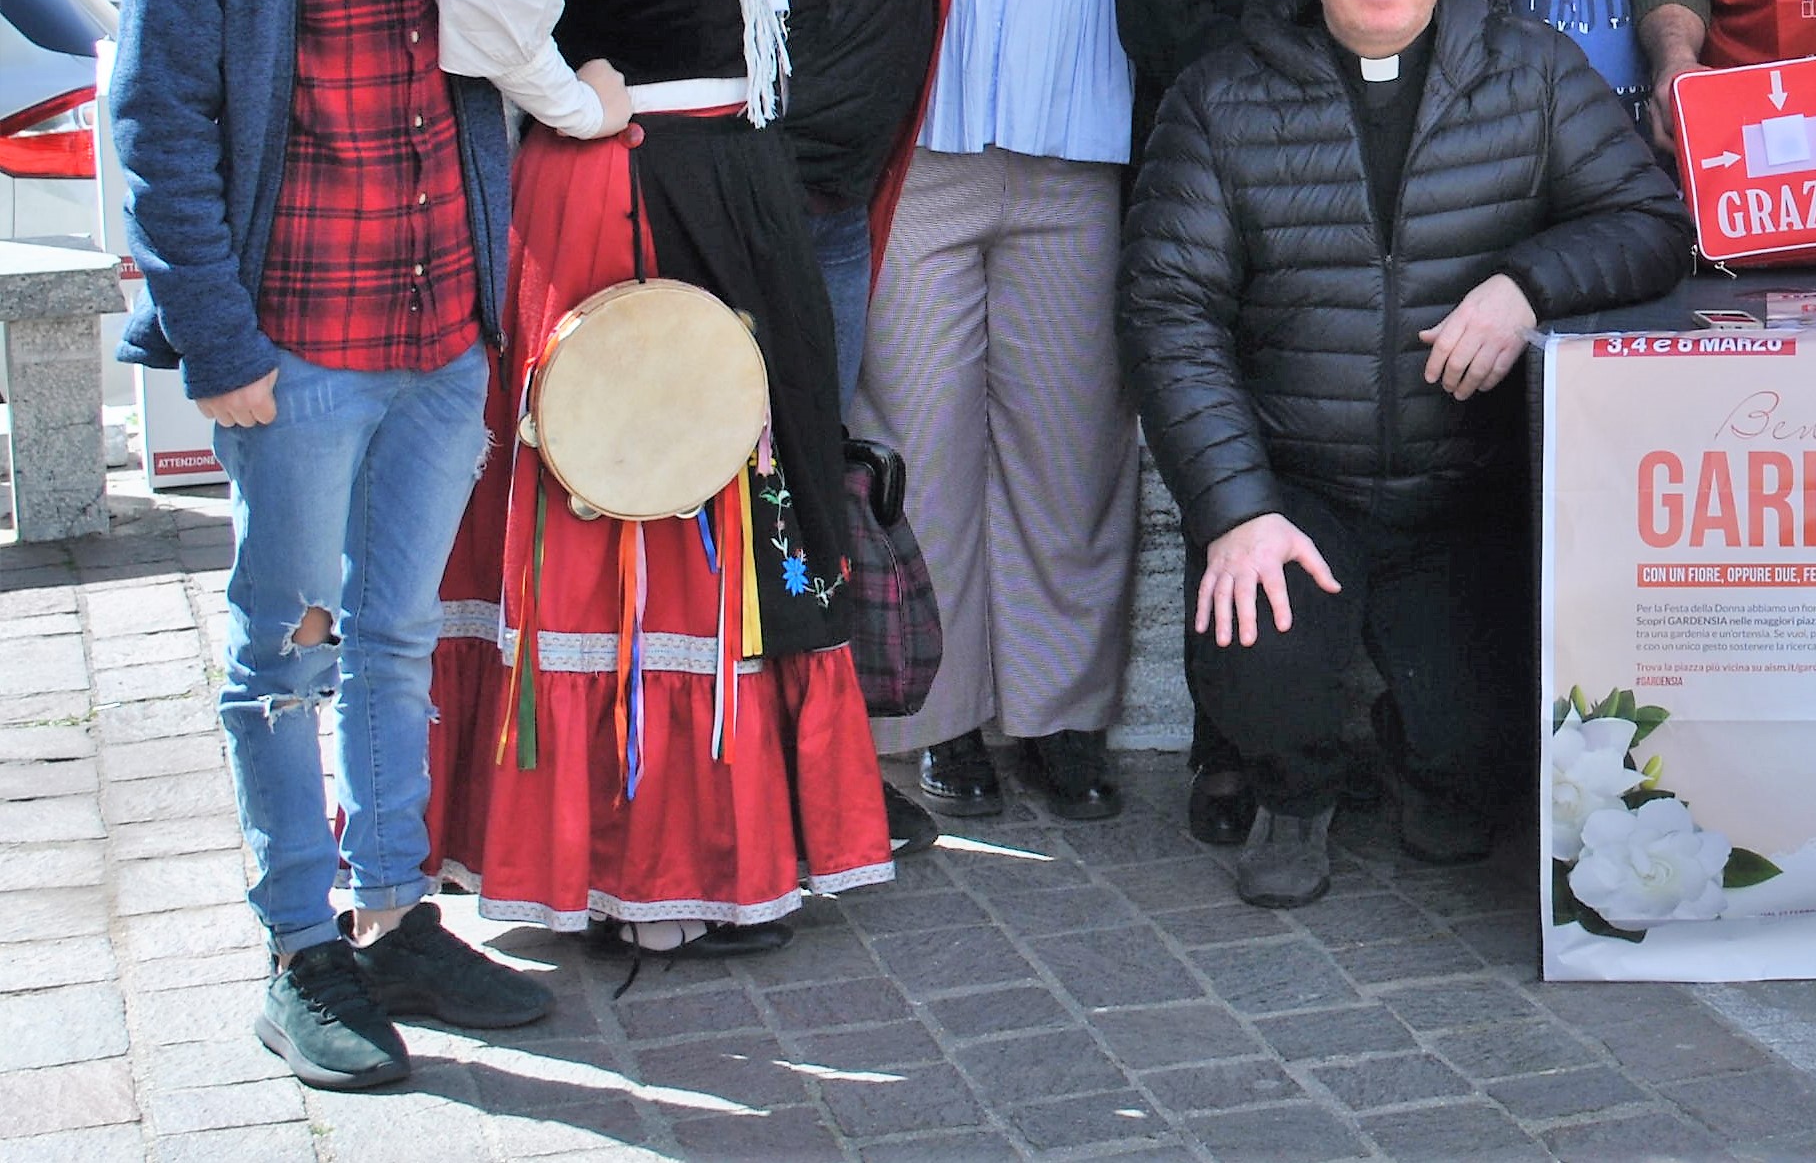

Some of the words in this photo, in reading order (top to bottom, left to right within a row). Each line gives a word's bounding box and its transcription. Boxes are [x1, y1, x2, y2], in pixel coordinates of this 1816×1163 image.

[1700, 338, 1782, 352] MARZO
[158, 456, 216, 469] ATTENZIONE
[1643, 567, 1666, 582] CON
[1669, 567, 1685, 582] UN
[1688, 567, 1725, 585] FIORE,
[1727, 567, 1772, 582] OPPURE
[1775, 567, 1800, 585] DUE,
[1636, 604, 1651, 613] Per
[1654, 604, 1662, 613] la
[1664, 604, 1688, 613] Festa
[1690, 604, 1713, 613] della
[1715, 604, 1745, 613] Donna
[1747, 604, 1786, 613] abbiamo
[1788, 604, 1800, 613] un
[1636, 616, 1666, 627] Scopri
[1668, 616, 1727, 627] GARDENSIA
[1729, 616, 1752, 627] nelle
[1754, 616, 1794, 627] maggiori
[1636, 630, 1650, 639] tra
[1651, 630, 1668, 639] una
[1670, 630, 1710, 639] gardenia
[1773, 630, 1785, 639] Se
[1644, 643, 1660, 652] con
[1662, 643, 1673, 652] un
[1675, 643, 1700, 652] unico
[1702, 643, 1727, 654] gesto
[1729, 643, 1776, 652] sostenere
[1776, 643, 1784, 652] la
[1786, 643, 1816, 652] ricerca
[1636, 663, 1663, 673] Trova
[1664, 663, 1673, 673] la
[1675, 663, 1704, 673] piazza
[1705, 663, 1719, 673] più
[1723, 663, 1750, 673] vicina
[1752, 663, 1762, 673] su
[1636, 676, 1683, 686] #GARDENSIA
